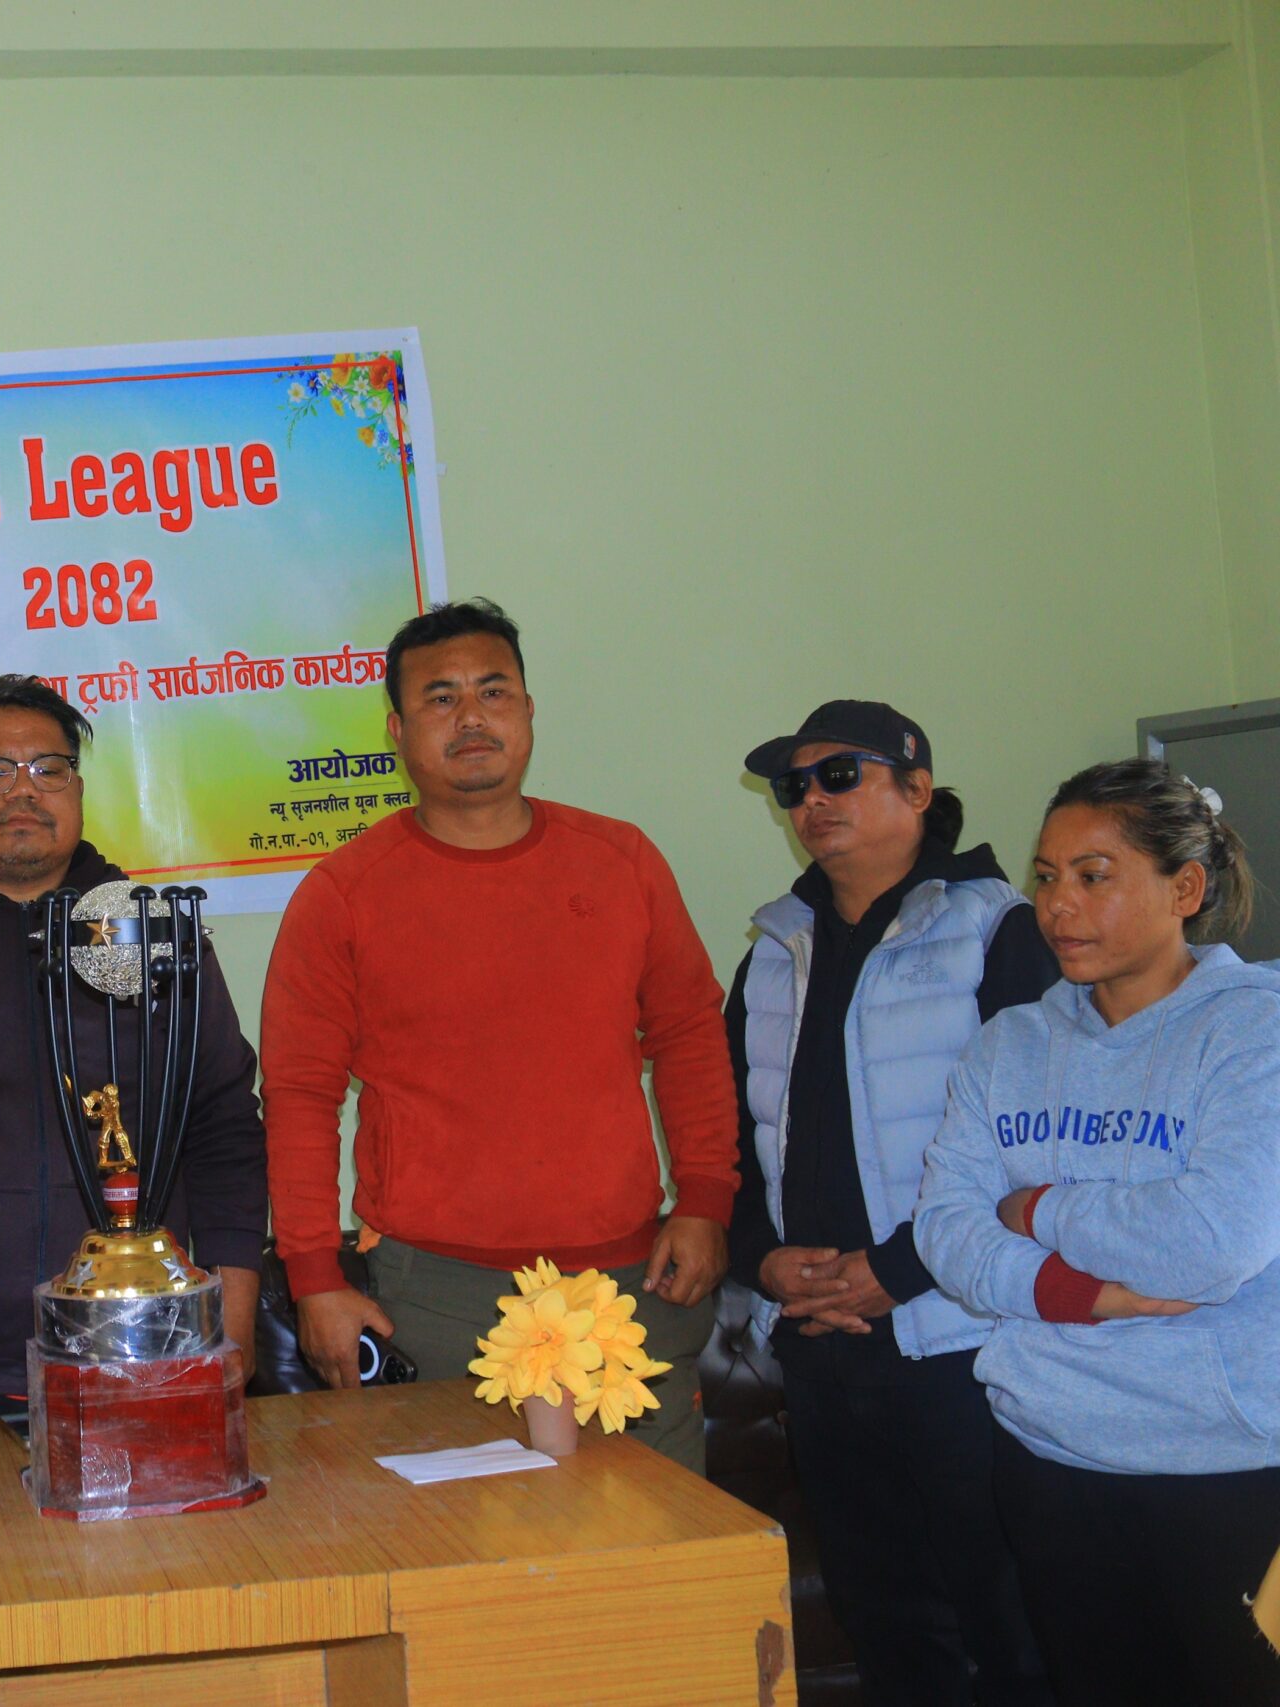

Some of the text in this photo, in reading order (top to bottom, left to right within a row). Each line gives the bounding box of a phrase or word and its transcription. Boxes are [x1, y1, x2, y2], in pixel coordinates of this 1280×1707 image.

[23, 438, 278, 533] League
[22, 559, 158, 630] 2082
[77, 661, 139, 714] ट्रफी
[147, 650, 285, 702] सार्वजनिक
[293, 645, 387, 686] कार्यक्र
[287, 749, 396, 783] आयोजक
[290, 793, 350, 821] सृजनशील
[996, 1107, 1051, 1149] GOO
